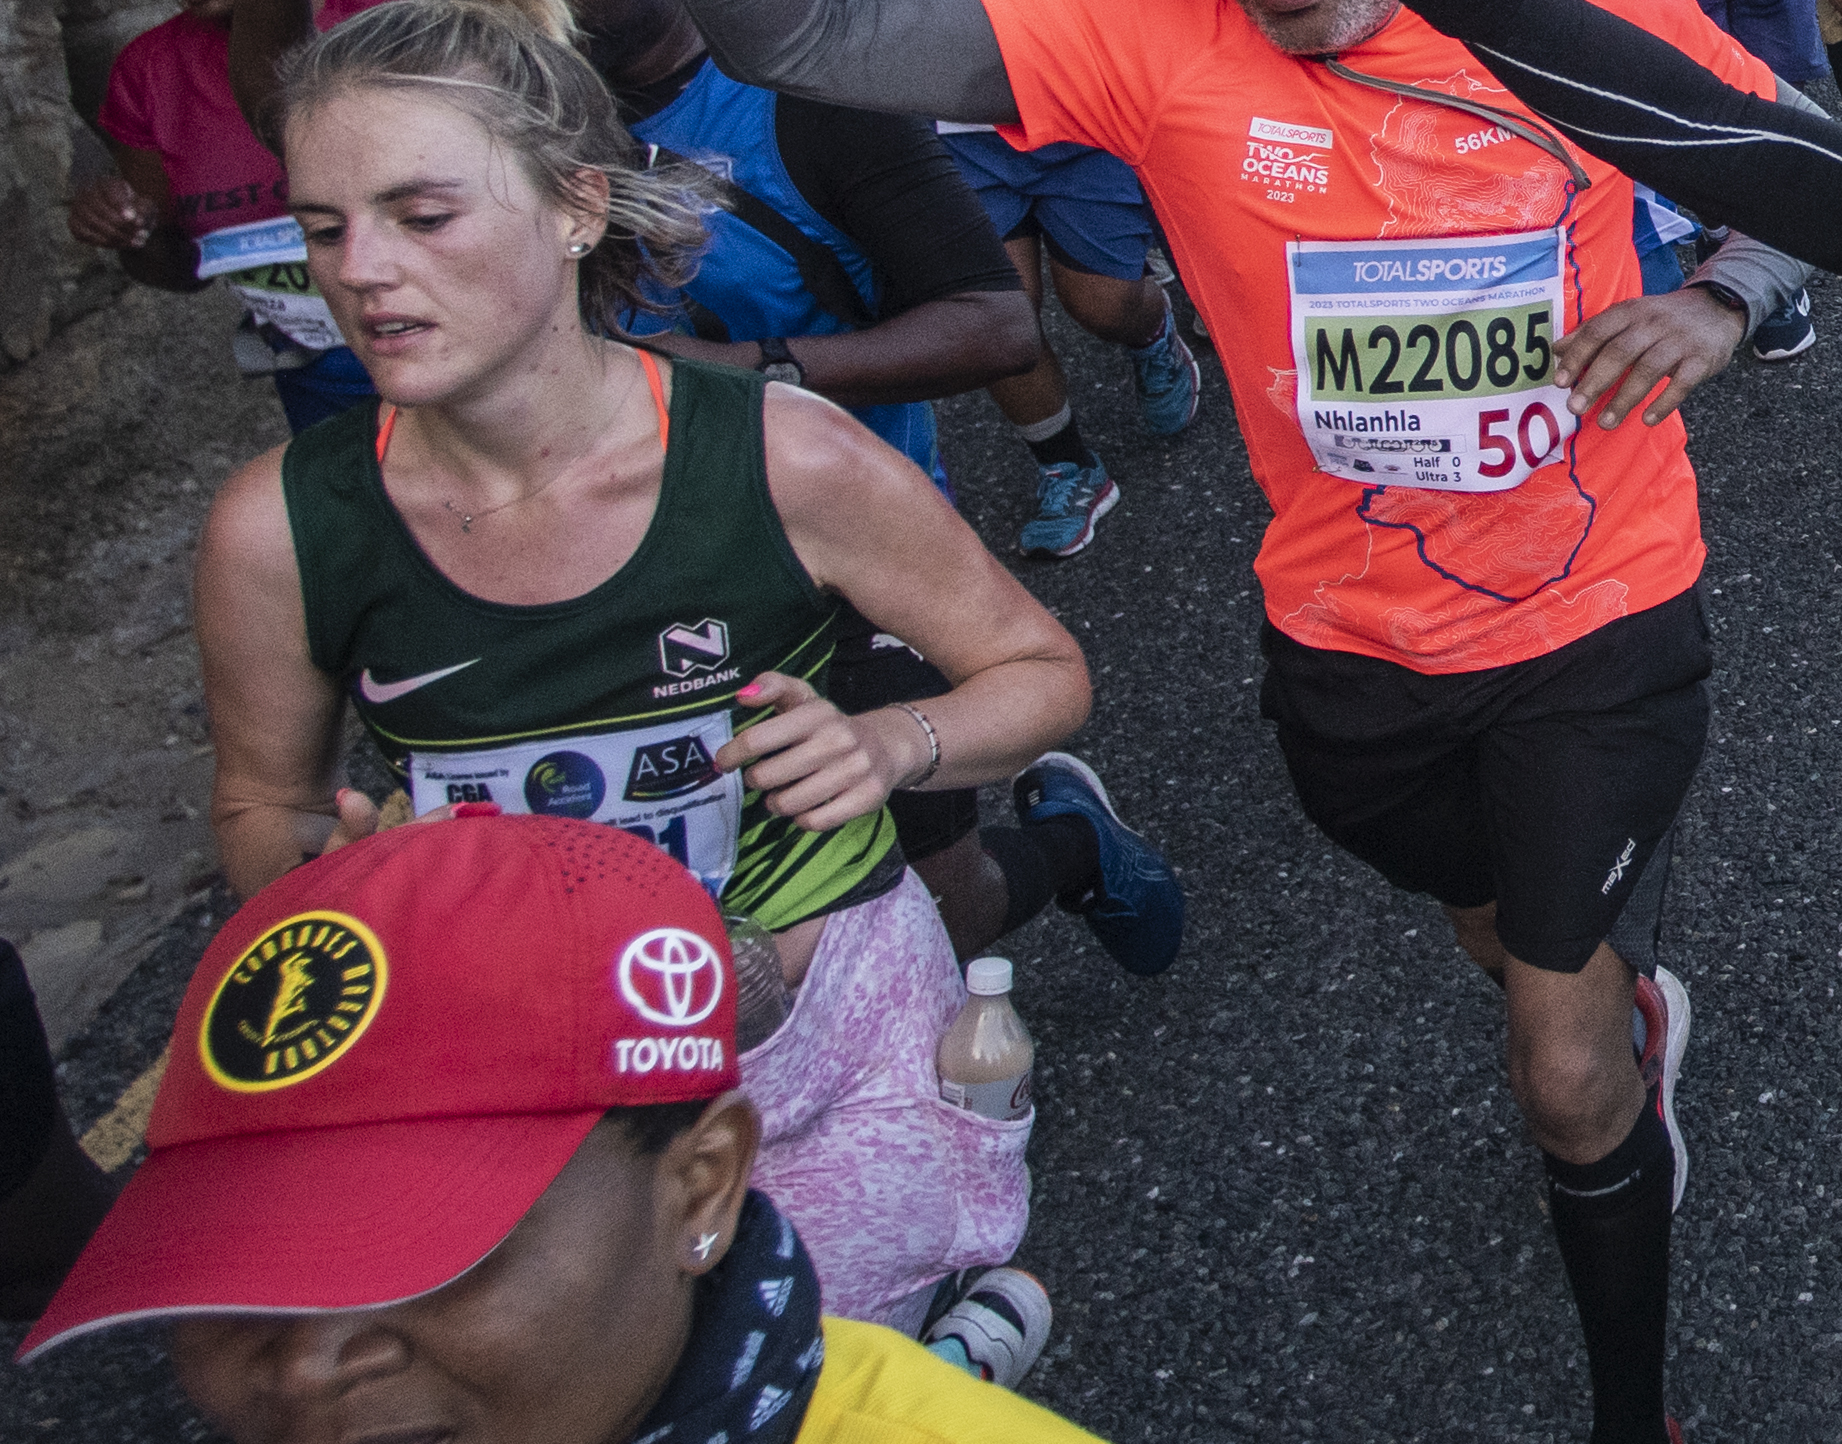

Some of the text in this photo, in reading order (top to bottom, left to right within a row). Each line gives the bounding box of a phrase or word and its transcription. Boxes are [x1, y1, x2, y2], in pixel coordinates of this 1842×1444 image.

[1256, 121, 1328, 145] TOTALSPORTS
[1246, 141, 1294, 161] TWO
[1240, 173, 1328, 194] MARATHON
[1242, 157, 1329, 185] OCEANS
[1266, 189, 1296, 204] 2023
[1353, 256, 1507, 283] TOTALSPORTS
[1309, 286, 1546, 309] 2023 TOTALSPORTS TWO OCEANS MARATHON
[1315, 310, 1550, 394] M22085
[1314, 409, 1421, 433] Nhlanhla
[1477, 401, 1561, 478] 50
[1413, 456, 1461, 468] Half 0
[1416, 471, 1462, 483] Ultra 3
[653, 666, 742, 699] NEDBANK
[635, 741, 706, 782] ASA
[232, 925, 358, 984] COMRADES
[615, 1035, 723, 1073] TOYOTA
